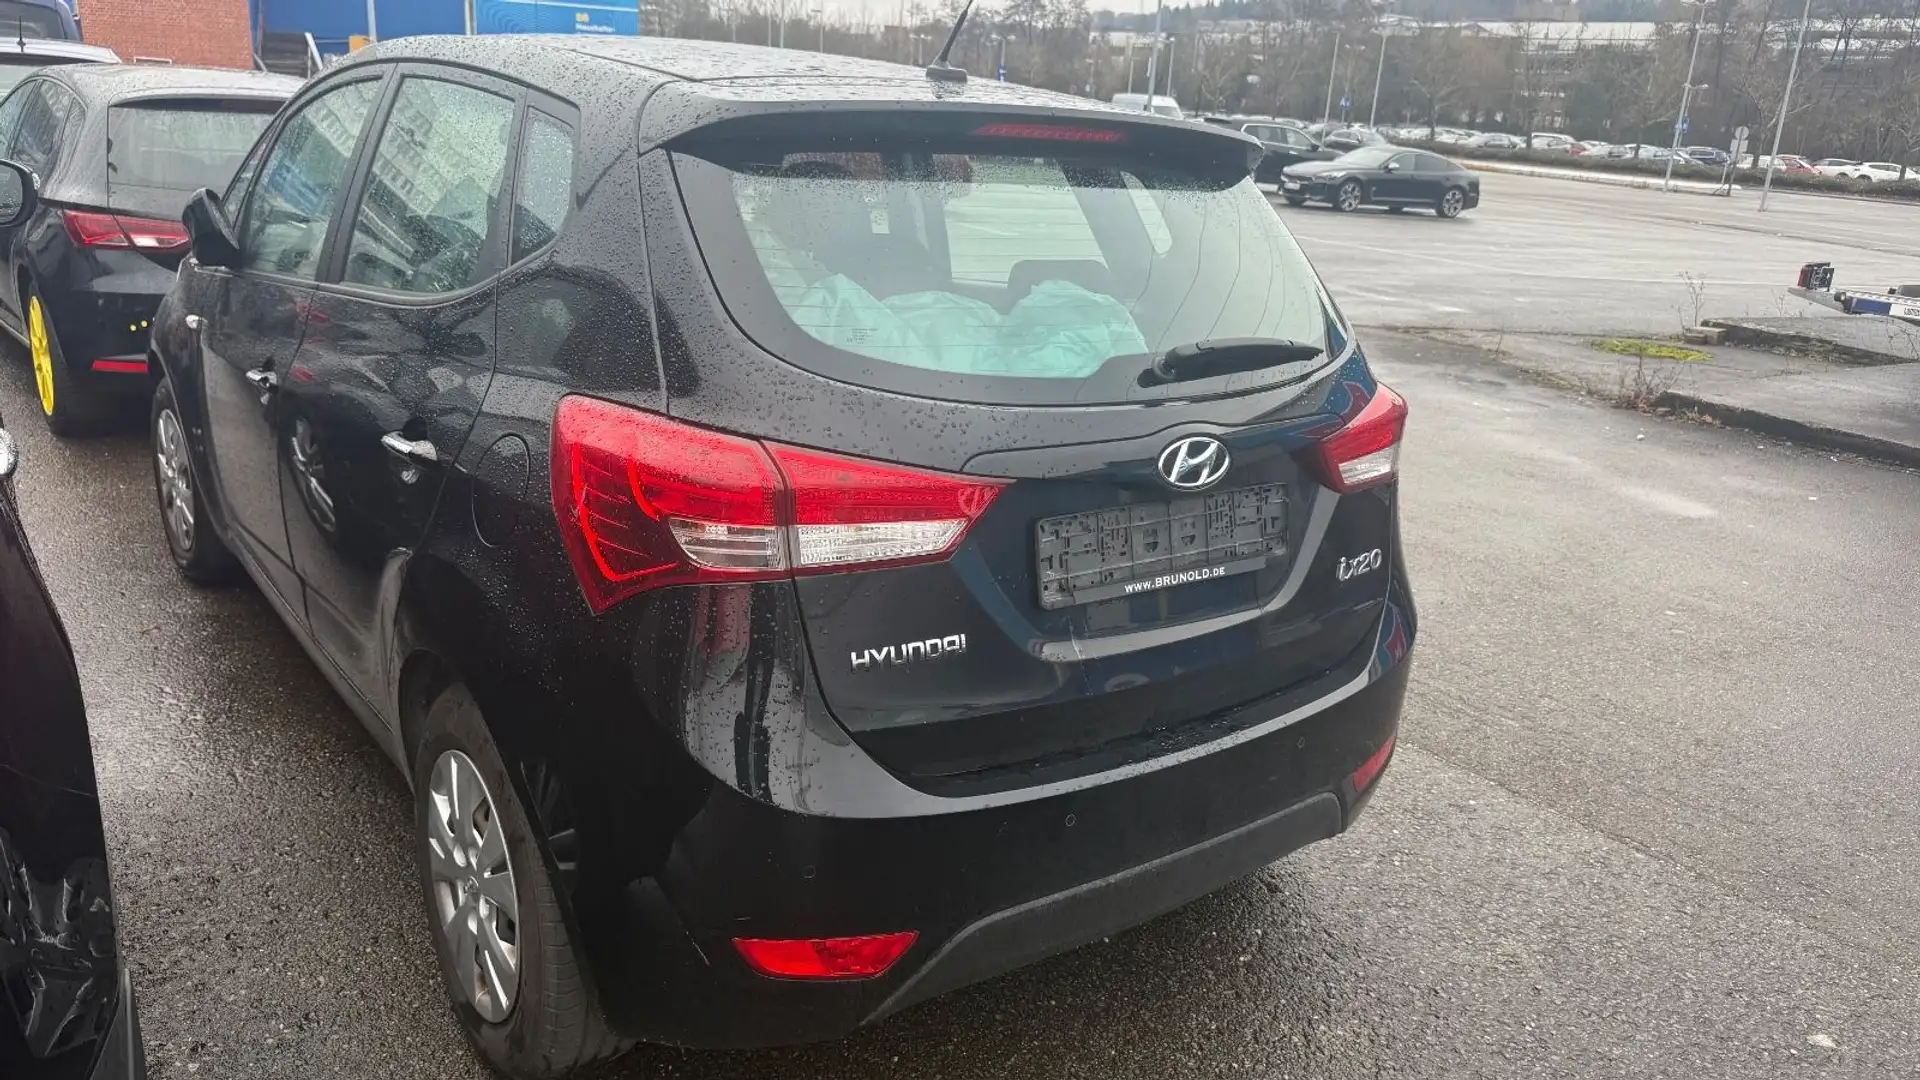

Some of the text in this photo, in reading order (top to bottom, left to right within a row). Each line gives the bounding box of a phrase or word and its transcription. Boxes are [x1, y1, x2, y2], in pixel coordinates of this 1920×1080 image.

[1124, 566, 1226, 593] WWW.BRUNOLD.DE
[1338, 548, 1382, 581] ix20
[850, 633, 967, 671] HYUNDAI
